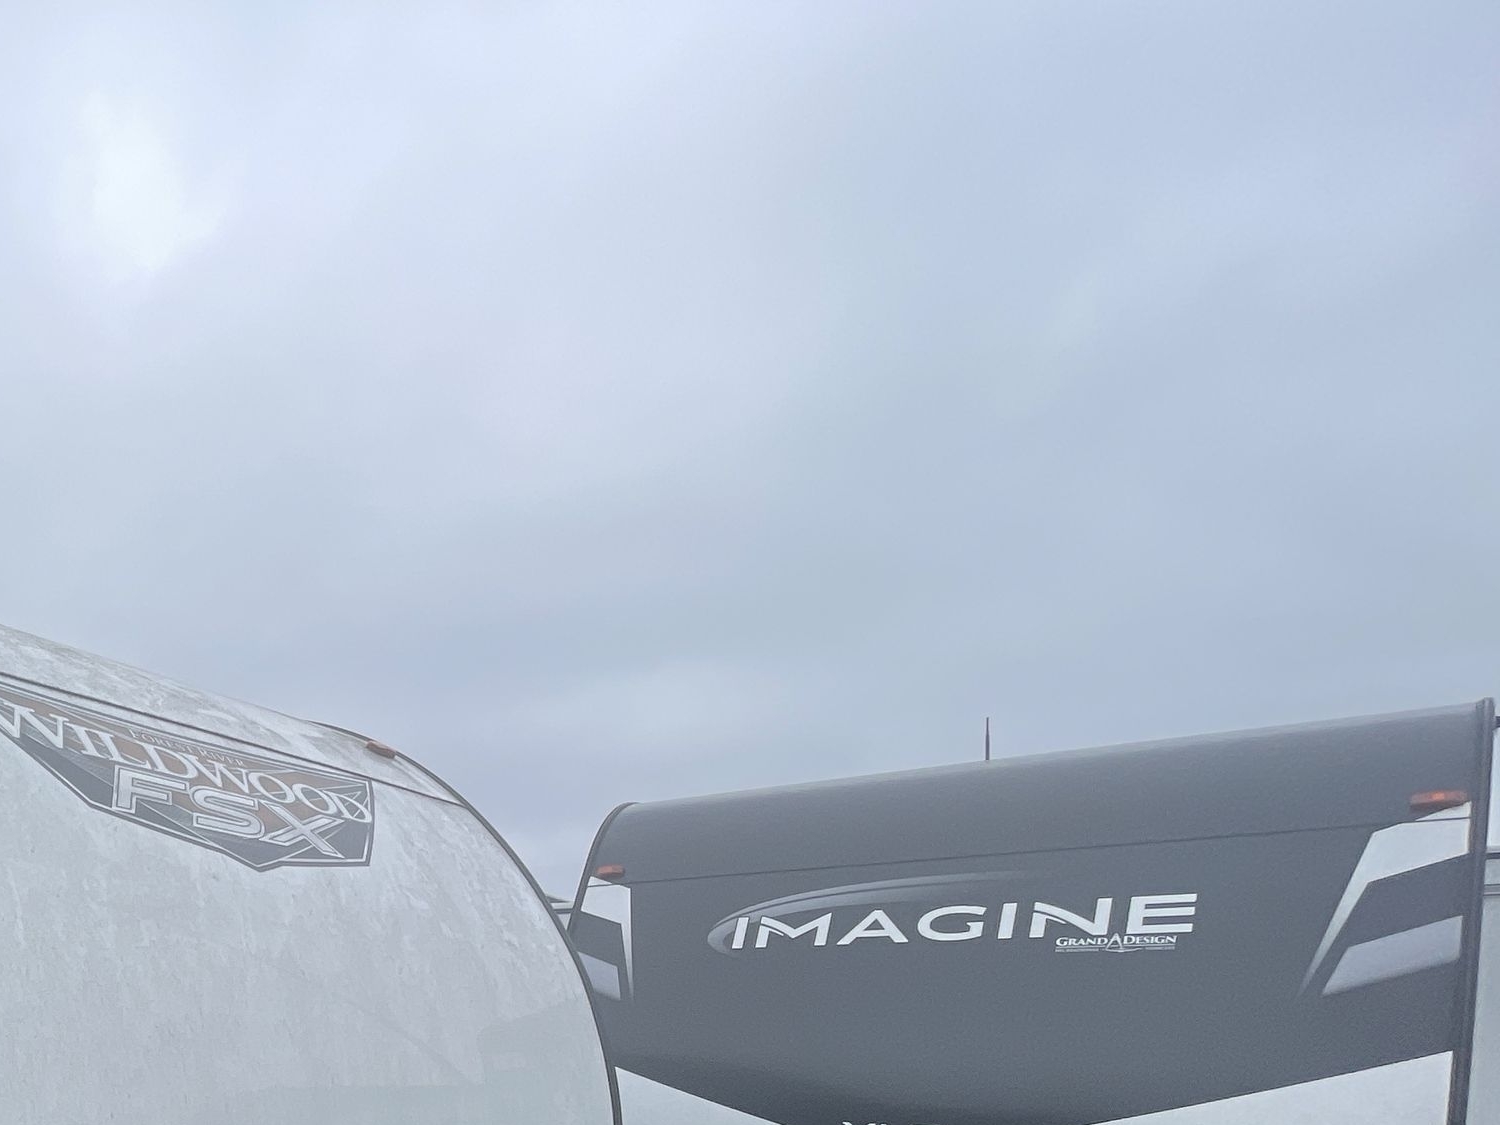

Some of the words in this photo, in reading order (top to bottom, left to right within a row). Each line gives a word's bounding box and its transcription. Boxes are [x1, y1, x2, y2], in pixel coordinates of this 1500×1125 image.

[111, 763, 345, 859] FSX
[730, 893, 1198, 950] IMAGINE
[1055, 936, 1109, 947] GRAND
[1123, 934, 1178, 945] DESIGN
